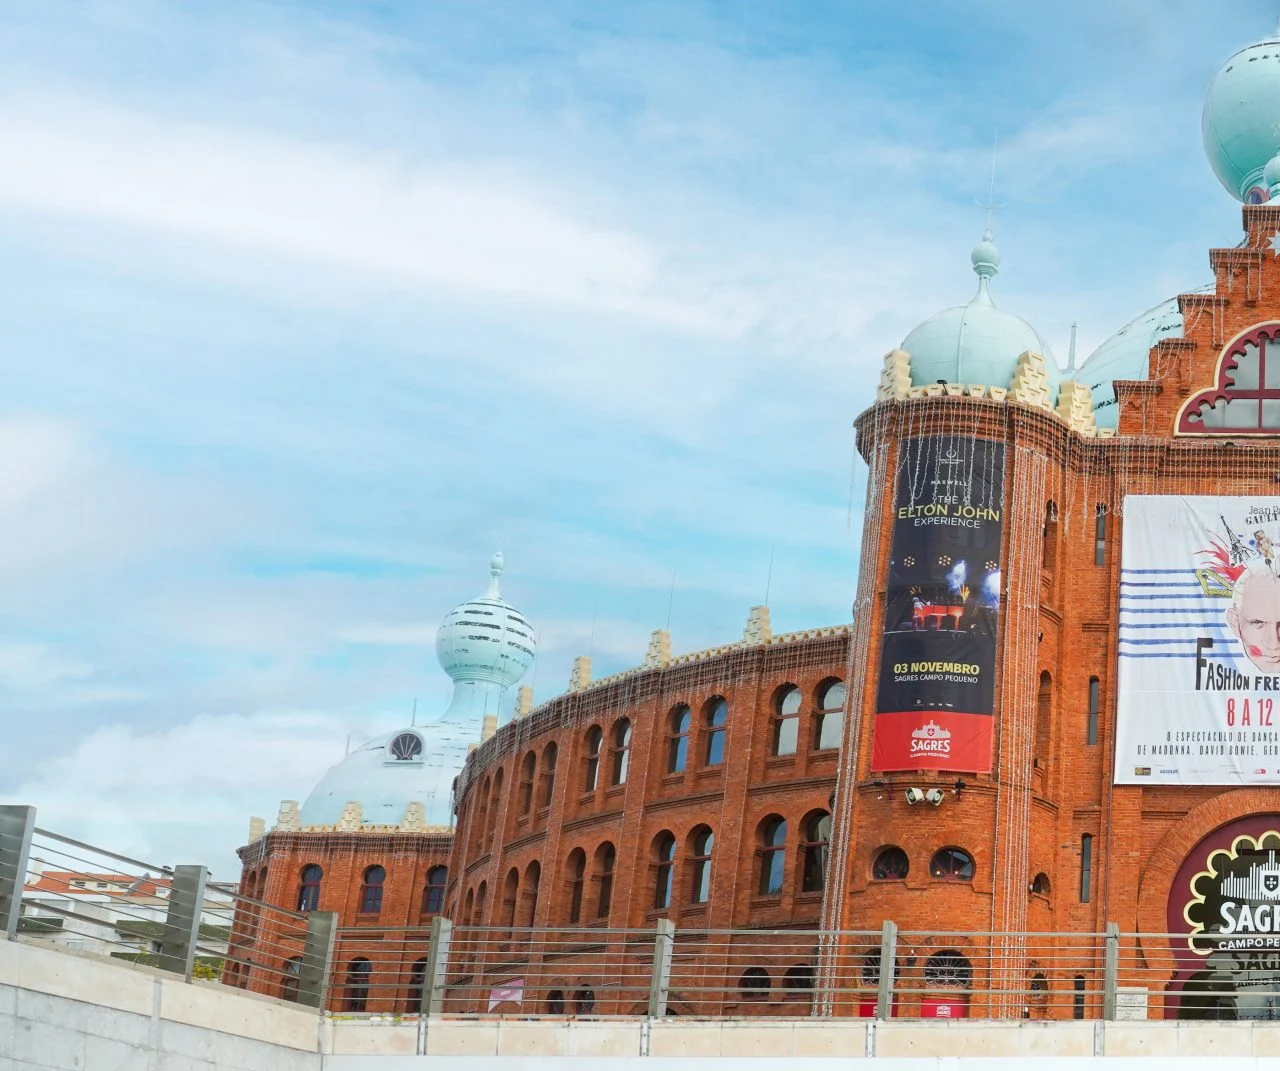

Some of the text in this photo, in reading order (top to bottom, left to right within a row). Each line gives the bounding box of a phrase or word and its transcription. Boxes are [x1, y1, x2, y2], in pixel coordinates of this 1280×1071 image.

[938, 495, 959, 505] THE
[898, 502, 1000, 522] ELTON JOHN
[1248, 505, 1271, 515] Jean
[914, 516, 981, 529] EXPERIENCE
[893, 661, 980, 675] 03 NOVEMBRO
[894, 673, 978, 684] SAGRES CAMPO PEQUENO
[1227, 698, 1235, 727] 8
[1241, 698, 1251, 727] A
[1257, 698, 1273, 727] 12
[1237, 731, 1247, 742] DE
[1252, 732, 1278, 744] DANÇA
[911, 739, 950, 753] SAGRES
[1137, 744, 1147, 755] DE
[1200, 745, 1224, 756] DAVID
[1218, 938, 1264, 951] CAMPO
